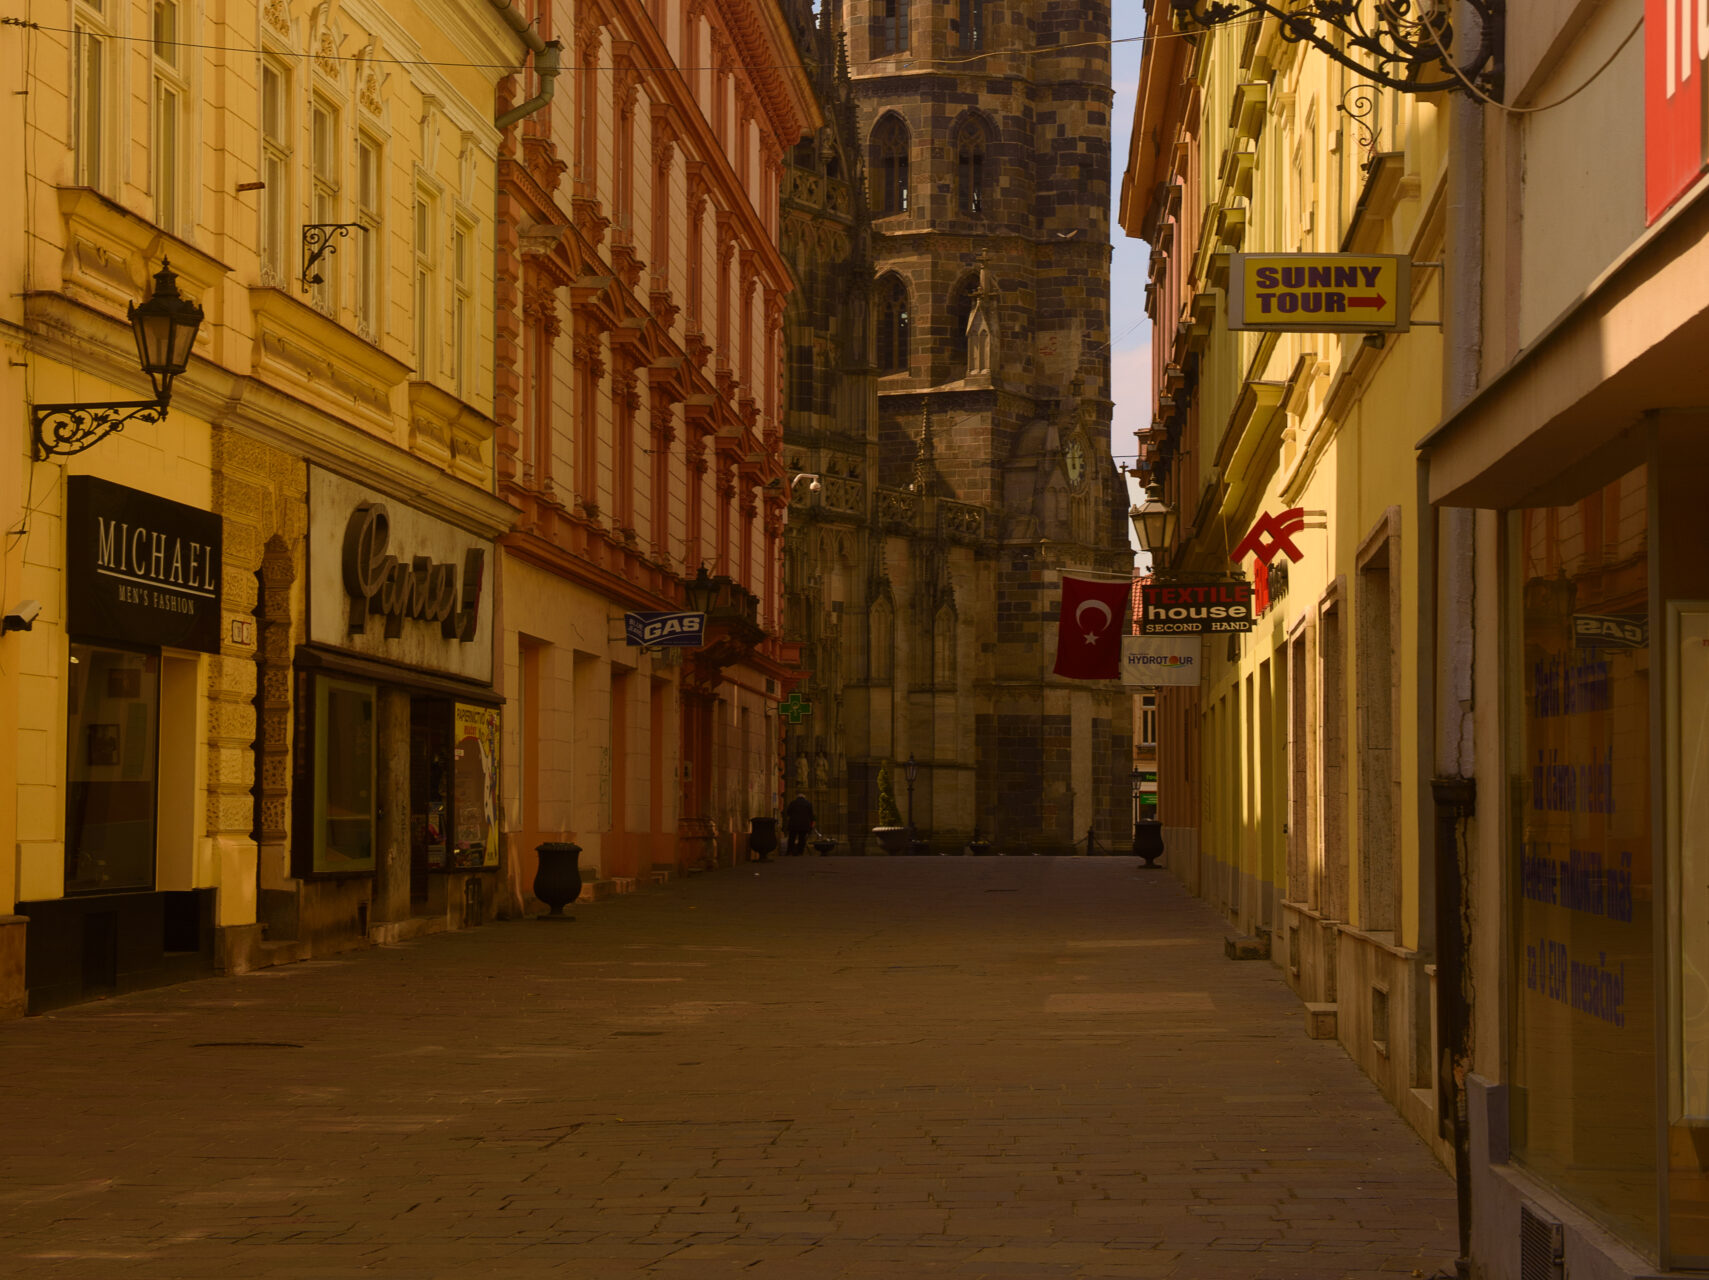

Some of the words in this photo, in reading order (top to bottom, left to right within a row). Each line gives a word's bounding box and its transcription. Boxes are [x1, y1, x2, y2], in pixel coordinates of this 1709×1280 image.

[1256, 266, 1382, 289] SUNNY
[1256, 292, 1348, 314] TOUR
[97, 516, 215, 590] MICHAEL
[118, 584, 149, 606] MEN'S
[153, 591, 195, 615] FASHION
[1144, 586, 1249, 604] TEXTILE
[1147, 605, 1248, 620] house
[644, 617, 701, 640] GAS
[1146, 623, 1202, 632] SECOND
[1211, 621, 1249, 631] HAND
[1128, 655, 1193, 665] HYDROTOUR
[1527, 944, 1536, 990] za
[1548, 939, 1568, 1004] EUR
[1571, 951, 1624, 1028] mesačne!
